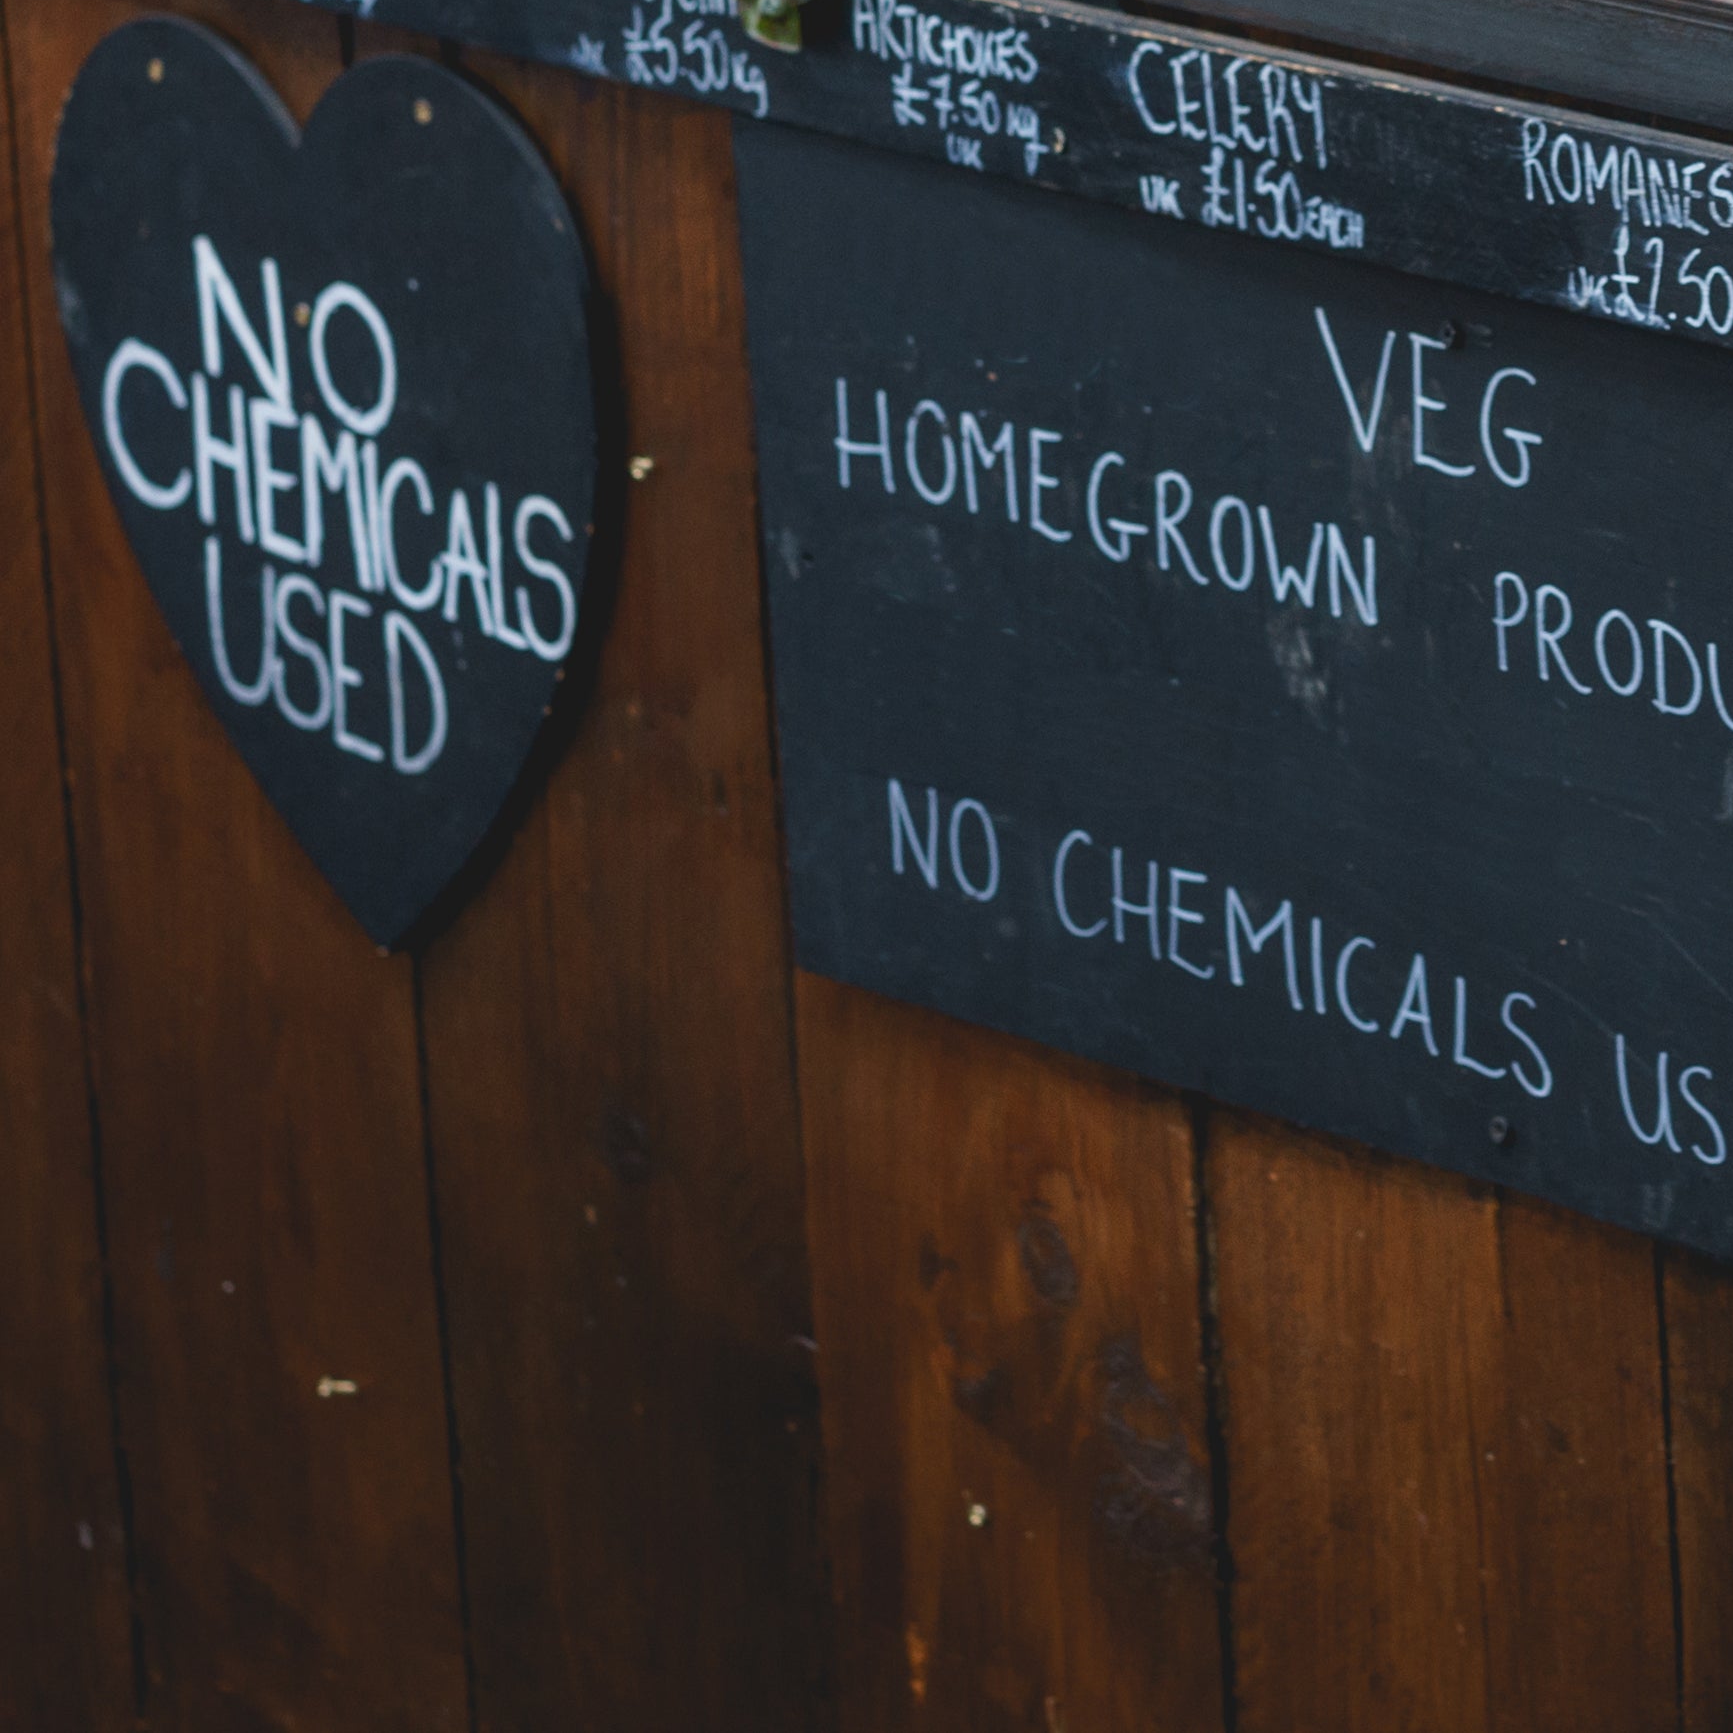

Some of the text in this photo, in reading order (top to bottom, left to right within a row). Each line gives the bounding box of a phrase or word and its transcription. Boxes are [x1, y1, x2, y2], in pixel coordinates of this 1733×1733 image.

[1127, 40, 1328, 169] CELERY
[1138, 175, 1185, 219] UK
[192, 234, 398, 436] NO
[1316, 306, 1542, 486] VEG
[102, 337, 575, 662] CHEMICALS
[205, 534, 449, 775] USED
[887, 779, 1001, 901] NO
[1053, 828, 1552, 1098] CHEMICALS
